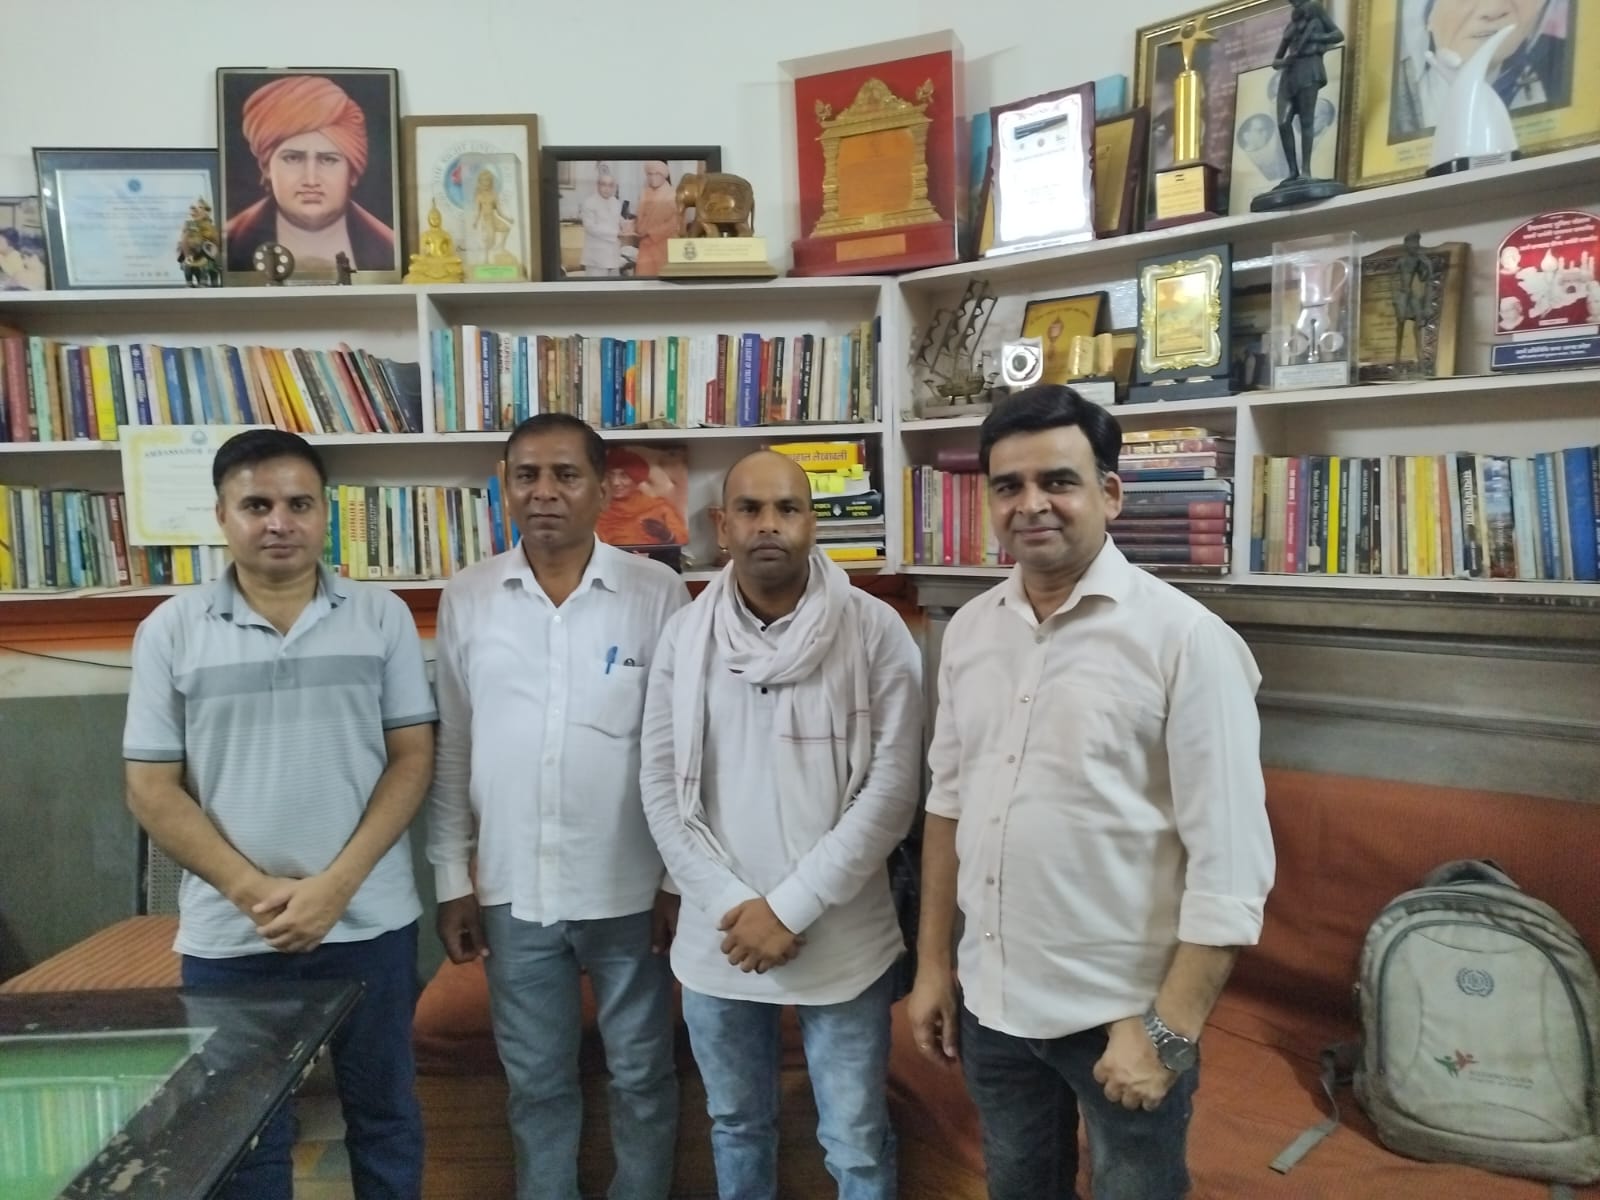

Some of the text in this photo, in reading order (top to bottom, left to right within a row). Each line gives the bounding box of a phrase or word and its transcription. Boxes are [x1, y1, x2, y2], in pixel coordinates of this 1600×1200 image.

[1312, 470, 1321, 487] South
[1312, 488, 1320, 500] Asia
[1312, 501, 1321, 518] China
